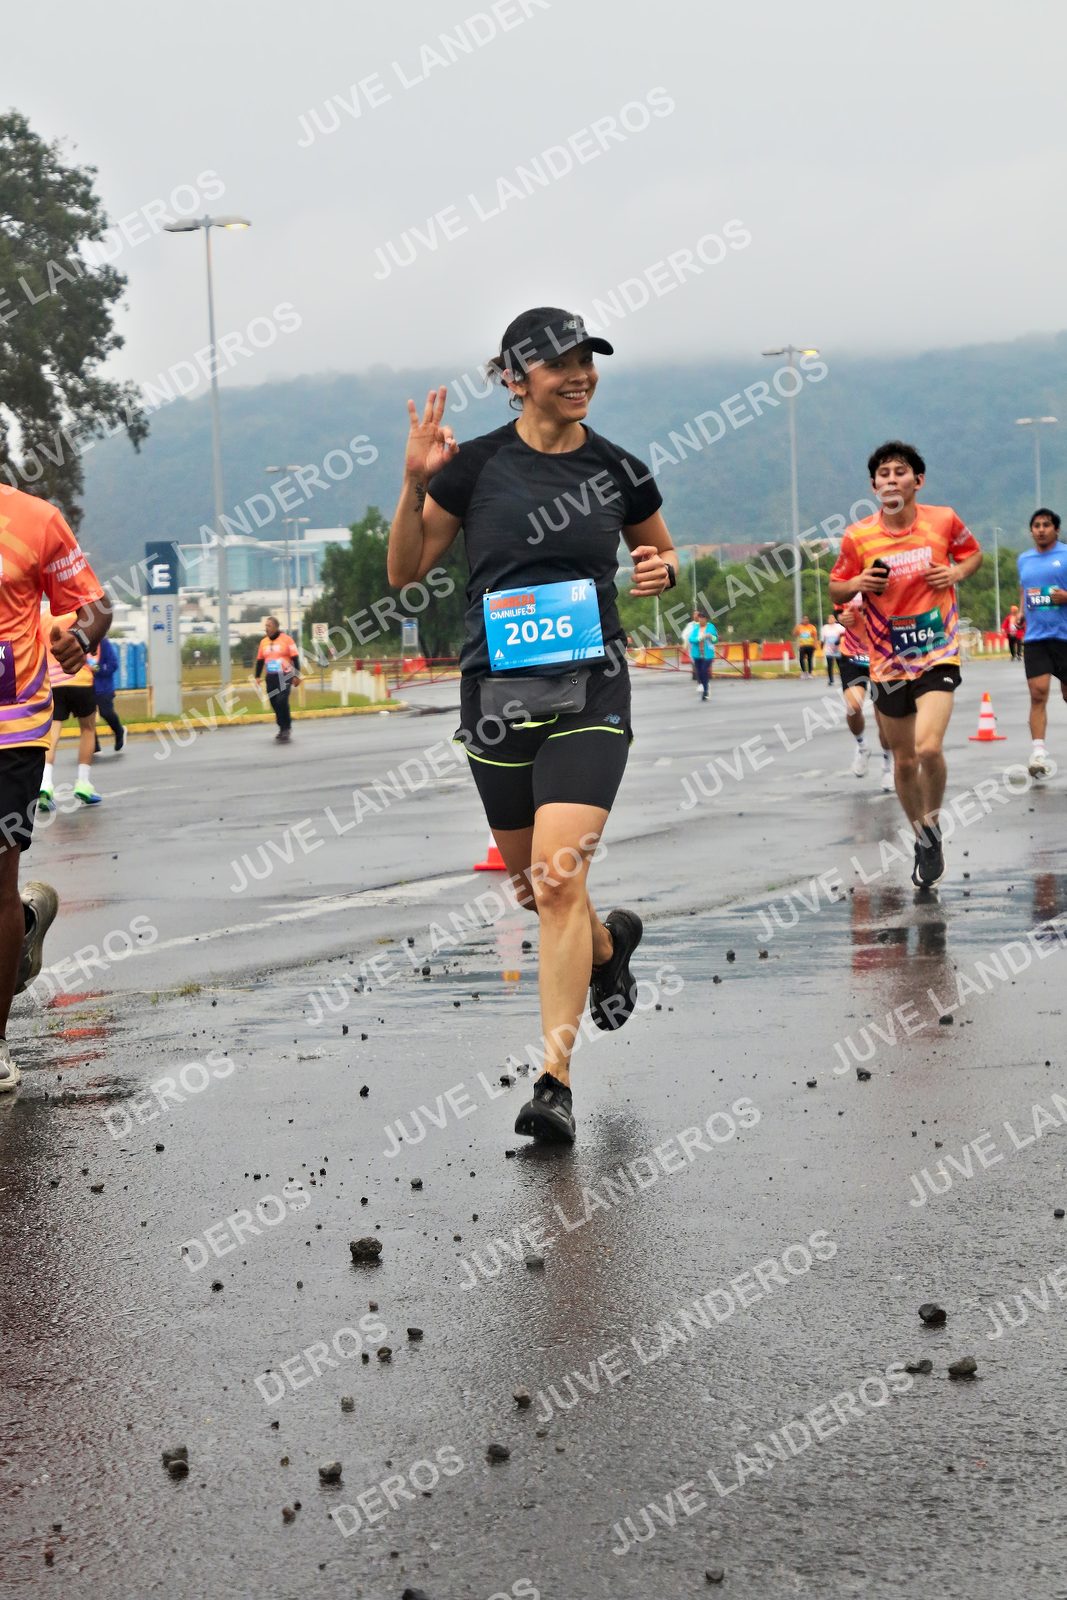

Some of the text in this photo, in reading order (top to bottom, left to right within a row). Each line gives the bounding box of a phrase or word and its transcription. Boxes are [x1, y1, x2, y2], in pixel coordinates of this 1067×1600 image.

[152, 563, 170, 587] E
[504, 615, 573, 646] 2026
[900, 627, 935, 644] 1164
